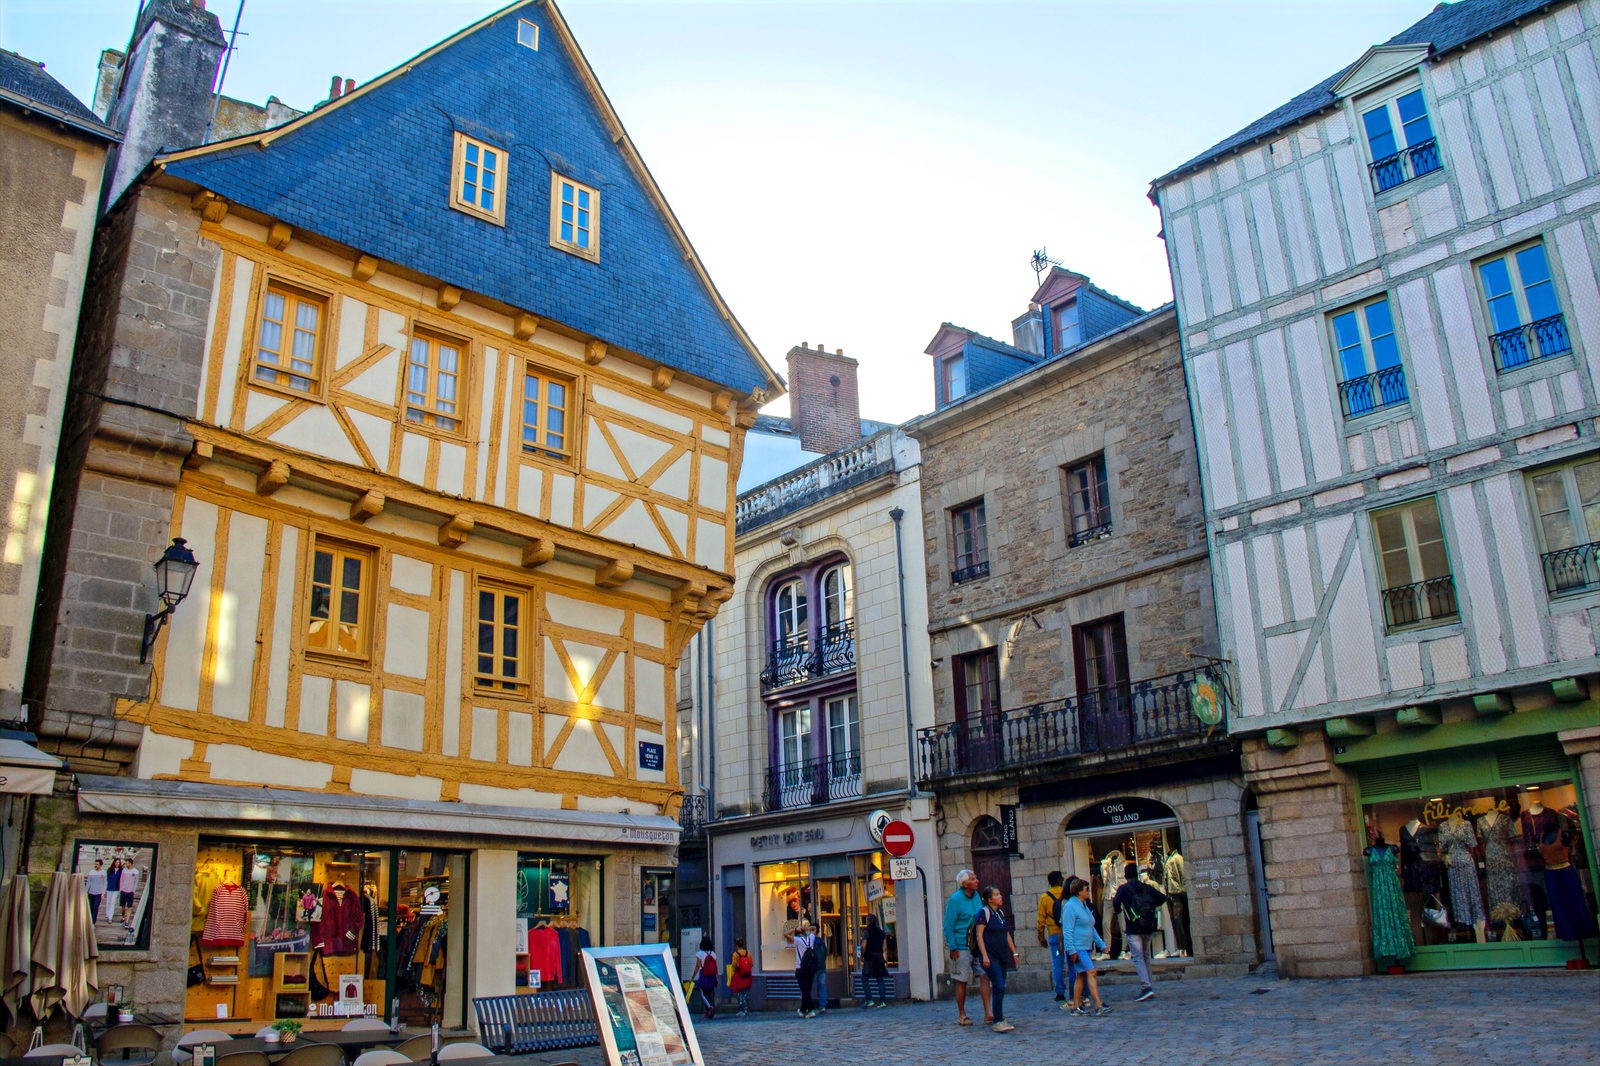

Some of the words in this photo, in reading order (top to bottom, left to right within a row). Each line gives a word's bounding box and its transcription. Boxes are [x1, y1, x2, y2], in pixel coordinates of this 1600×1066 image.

[1102, 804, 1124, 814] LONG
[1111, 813, 1140, 824] ISLAND
[895, 859, 911, 867] SAUF
